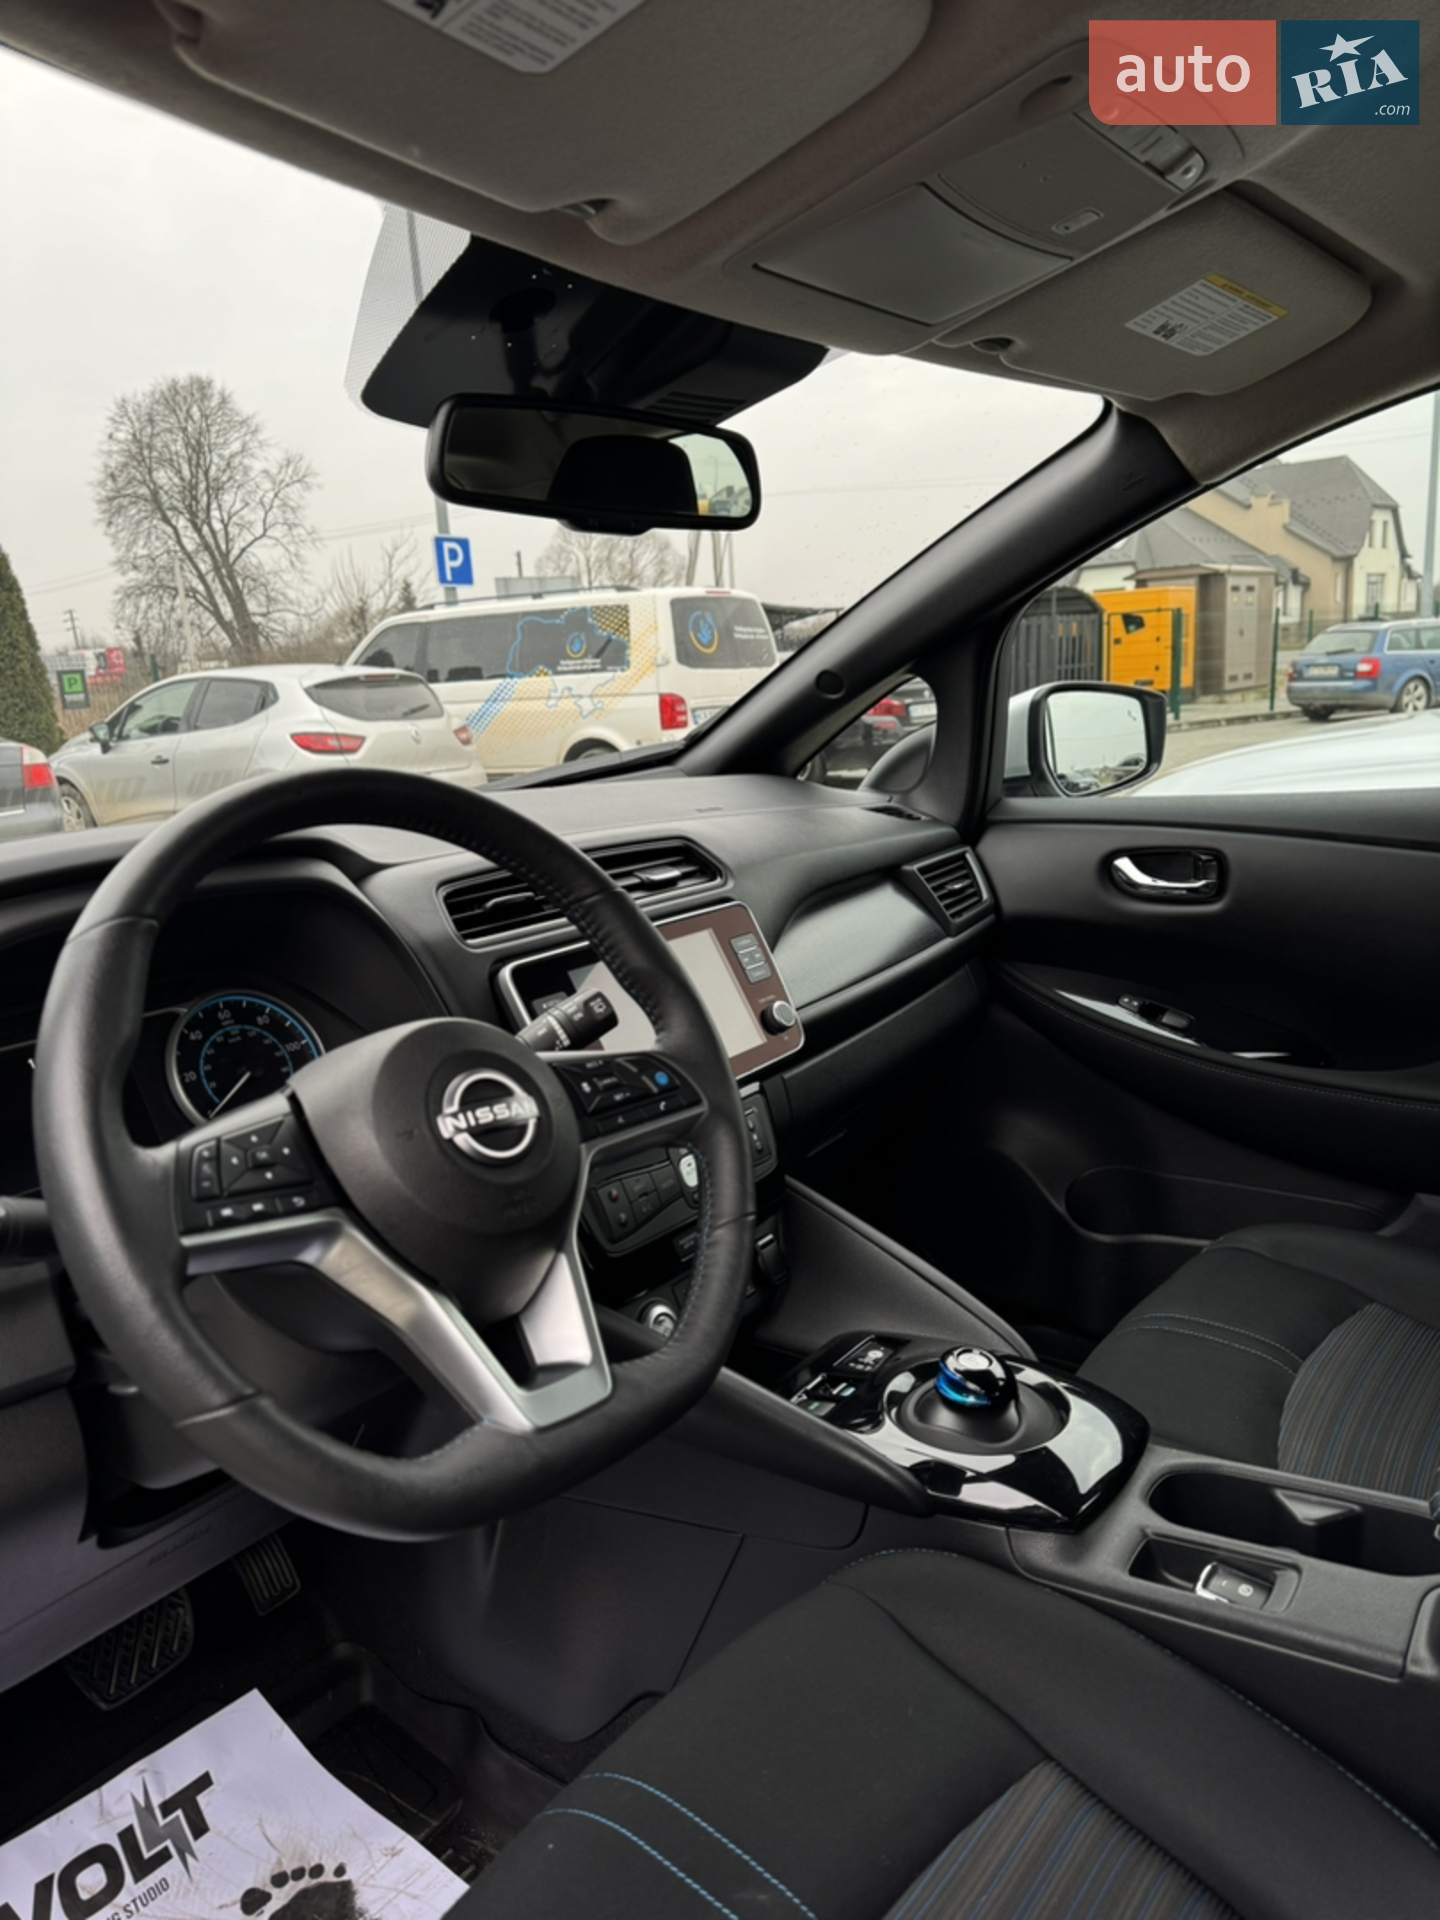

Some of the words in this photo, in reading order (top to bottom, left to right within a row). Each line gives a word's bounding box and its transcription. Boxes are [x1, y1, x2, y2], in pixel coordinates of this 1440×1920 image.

[442, 541, 464, 582] P
[66, 677, 78, 690] P
[217, 1009, 232, 1020] 60
[256, 1014, 270, 1026] 80
[188, 1030, 203, 1041] 40
[284, 1041, 301, 1052] 100
[183, 1070, 197, 1083] 20
[444, 1100, 539, 1132] NISSAN
[122, 1876, 170, 1919] STUDIO
